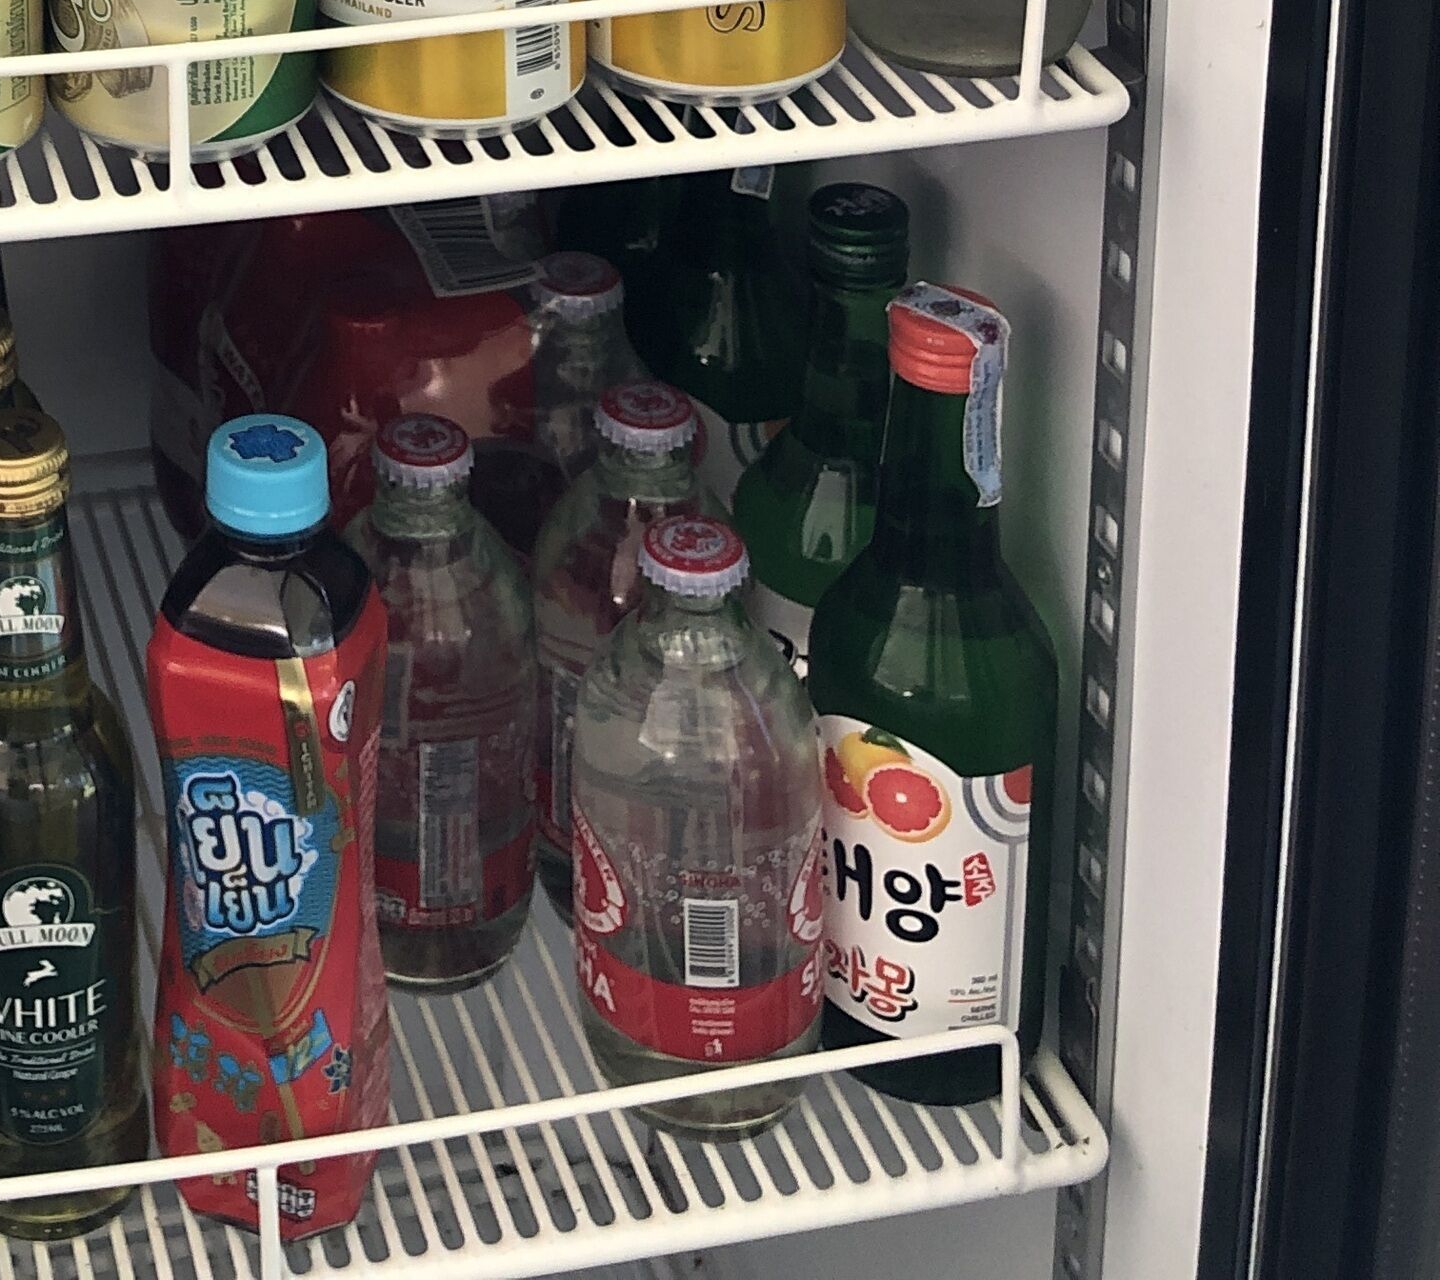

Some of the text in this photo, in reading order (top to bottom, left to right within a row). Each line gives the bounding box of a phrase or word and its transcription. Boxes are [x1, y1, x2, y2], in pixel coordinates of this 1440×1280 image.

[208, 864, 294, 932] เย็น
[41, 926, 89, 943] MOON
[29, 1019, 99, 1045] COOLER
